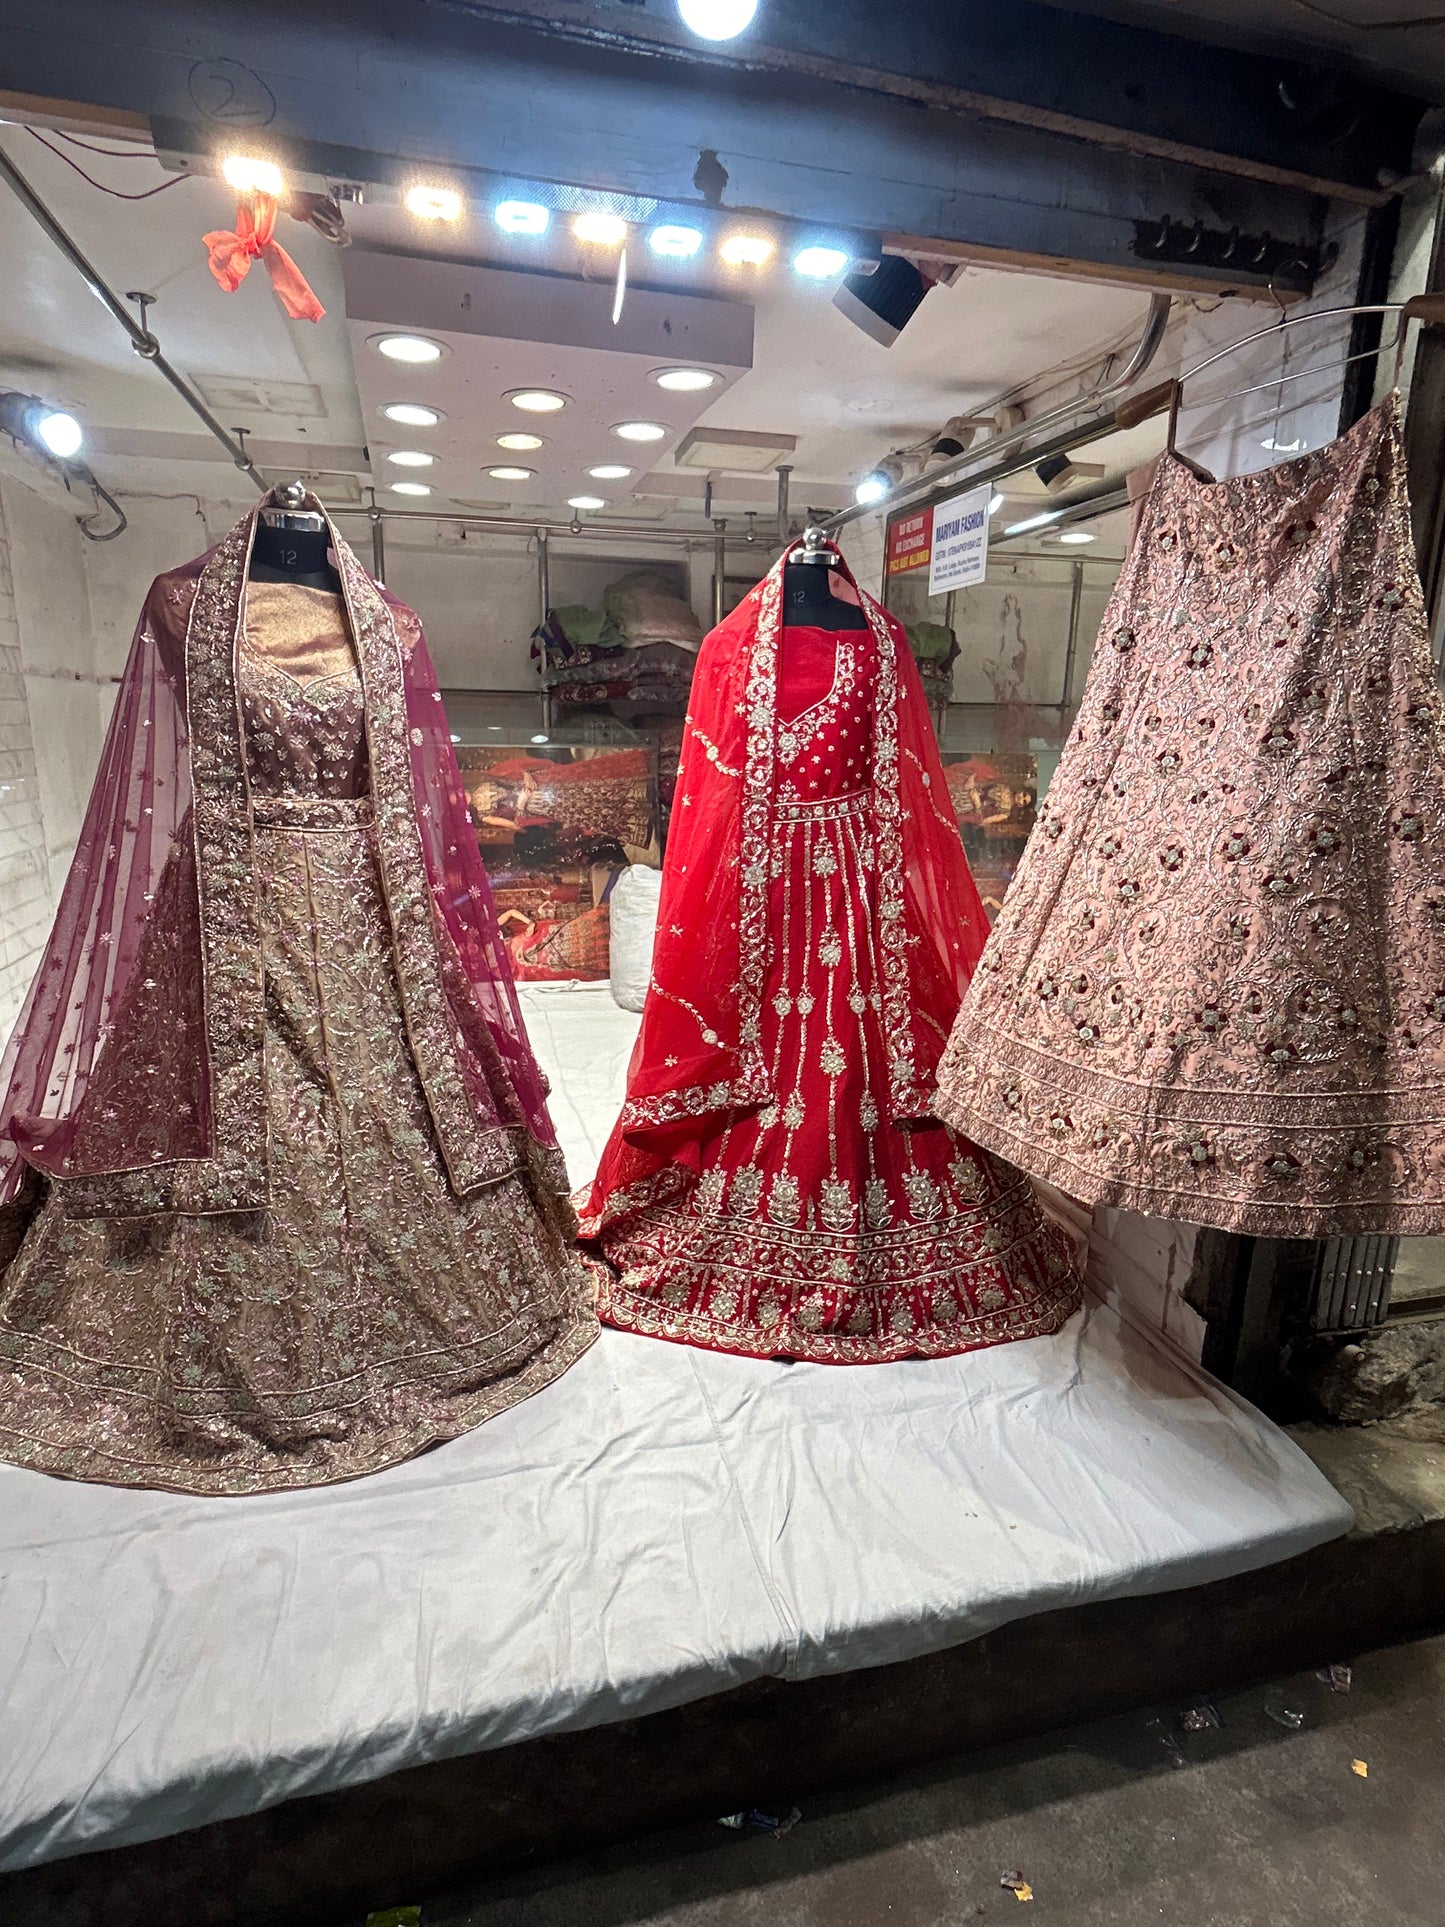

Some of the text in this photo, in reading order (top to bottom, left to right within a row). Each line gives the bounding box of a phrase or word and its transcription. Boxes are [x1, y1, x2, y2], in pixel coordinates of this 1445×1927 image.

[906, 516, 924, 533] RETURN
[936, 510, 984, 542] MARIYAM FASHION
[902, 533, 925, 552] EXCHANGE
[280, 550, 297, 565] 12
[900, 555, 909, 569] NOT
[909, 549, 929, 566] ALLOWED
[792, 590, 806, 603] 12
